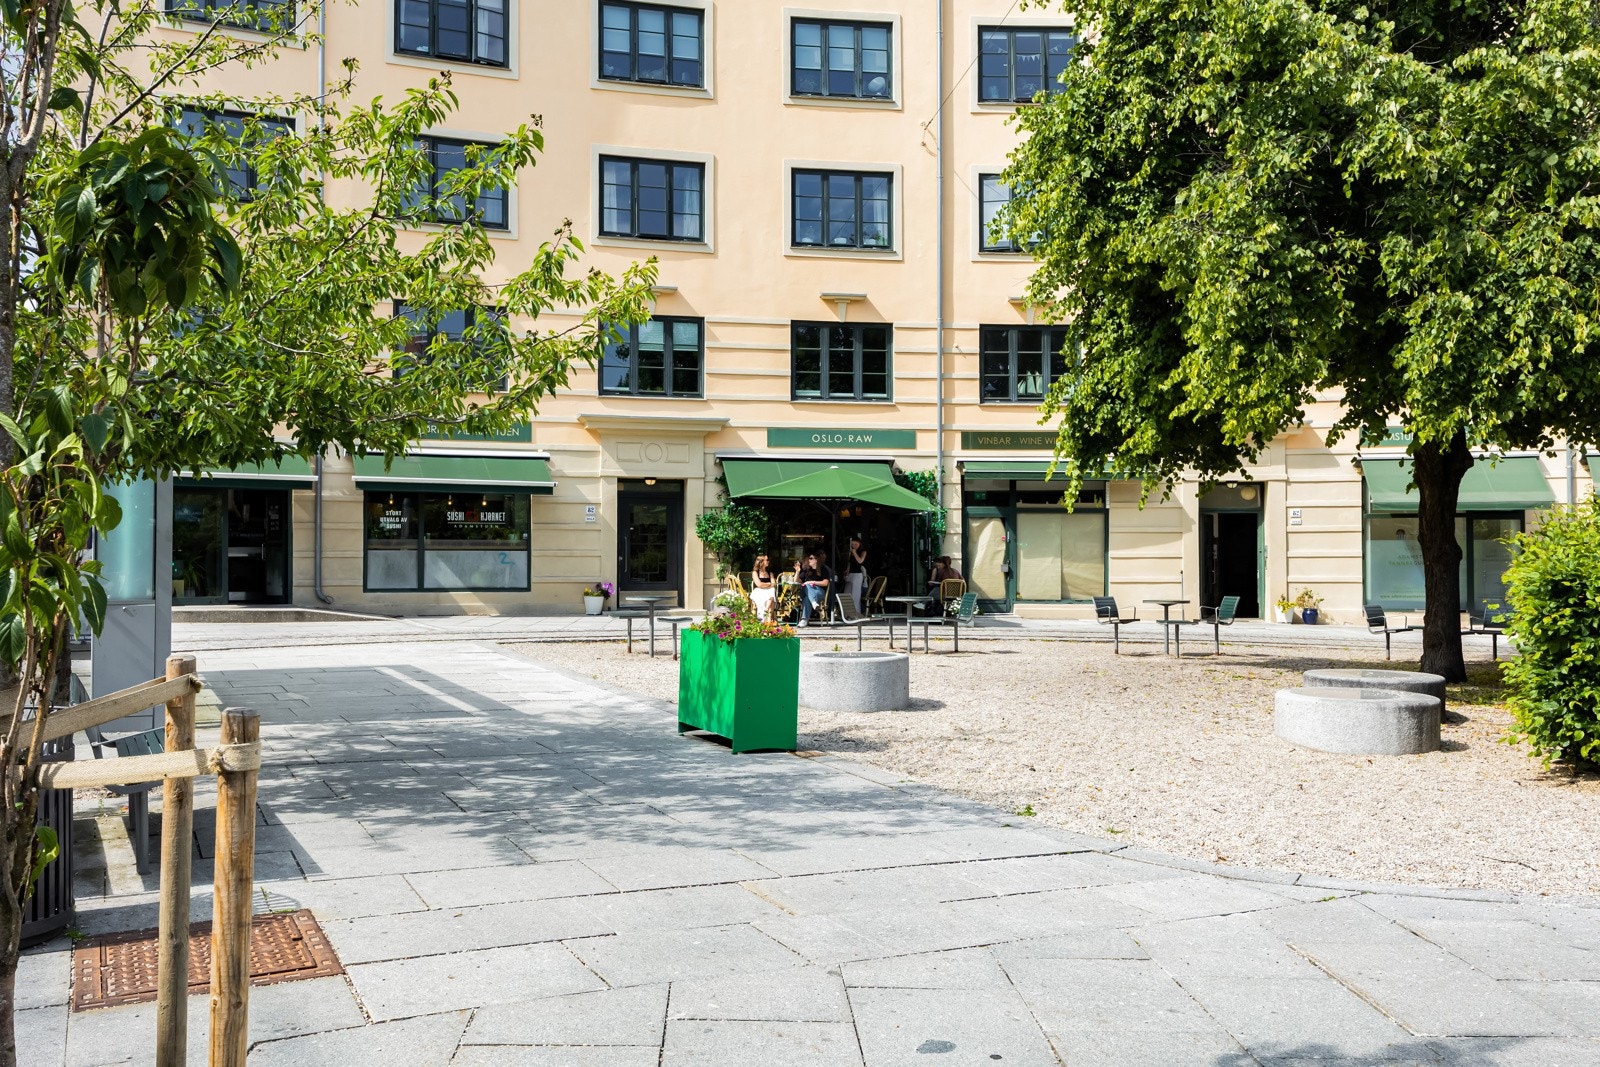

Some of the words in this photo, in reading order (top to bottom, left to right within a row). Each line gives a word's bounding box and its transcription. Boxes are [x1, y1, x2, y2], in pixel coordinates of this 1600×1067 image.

[977, 436, 1011, 445] VINBAR
[1020, 436, 1042, 446] WINE
[446, 511, 465, 521] SUSHI
